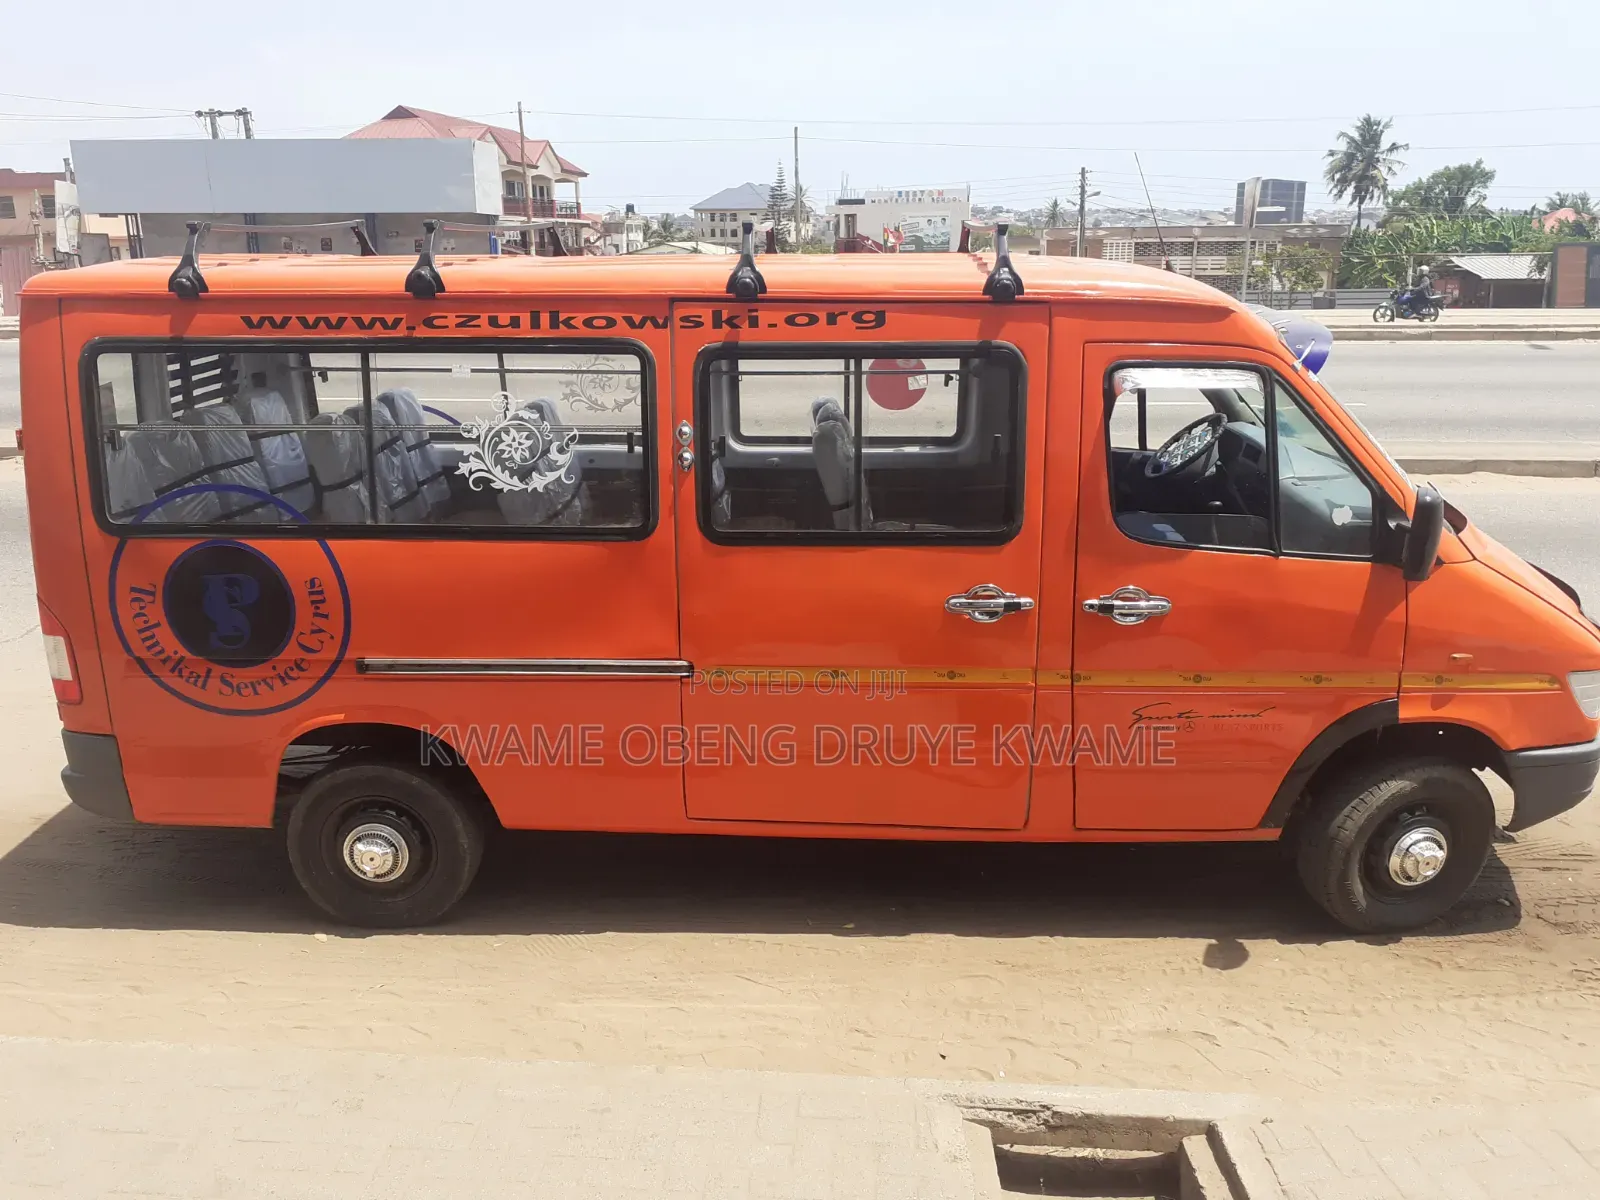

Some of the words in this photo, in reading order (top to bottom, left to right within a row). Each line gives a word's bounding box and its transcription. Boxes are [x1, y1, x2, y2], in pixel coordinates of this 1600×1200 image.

[240, 309, 887, 330] www.czulkowski.org
[130, 583, 212, 691] Technikal
[218, 656, 312, 698] Service
[296, 576, 335, 654] Cyrus
